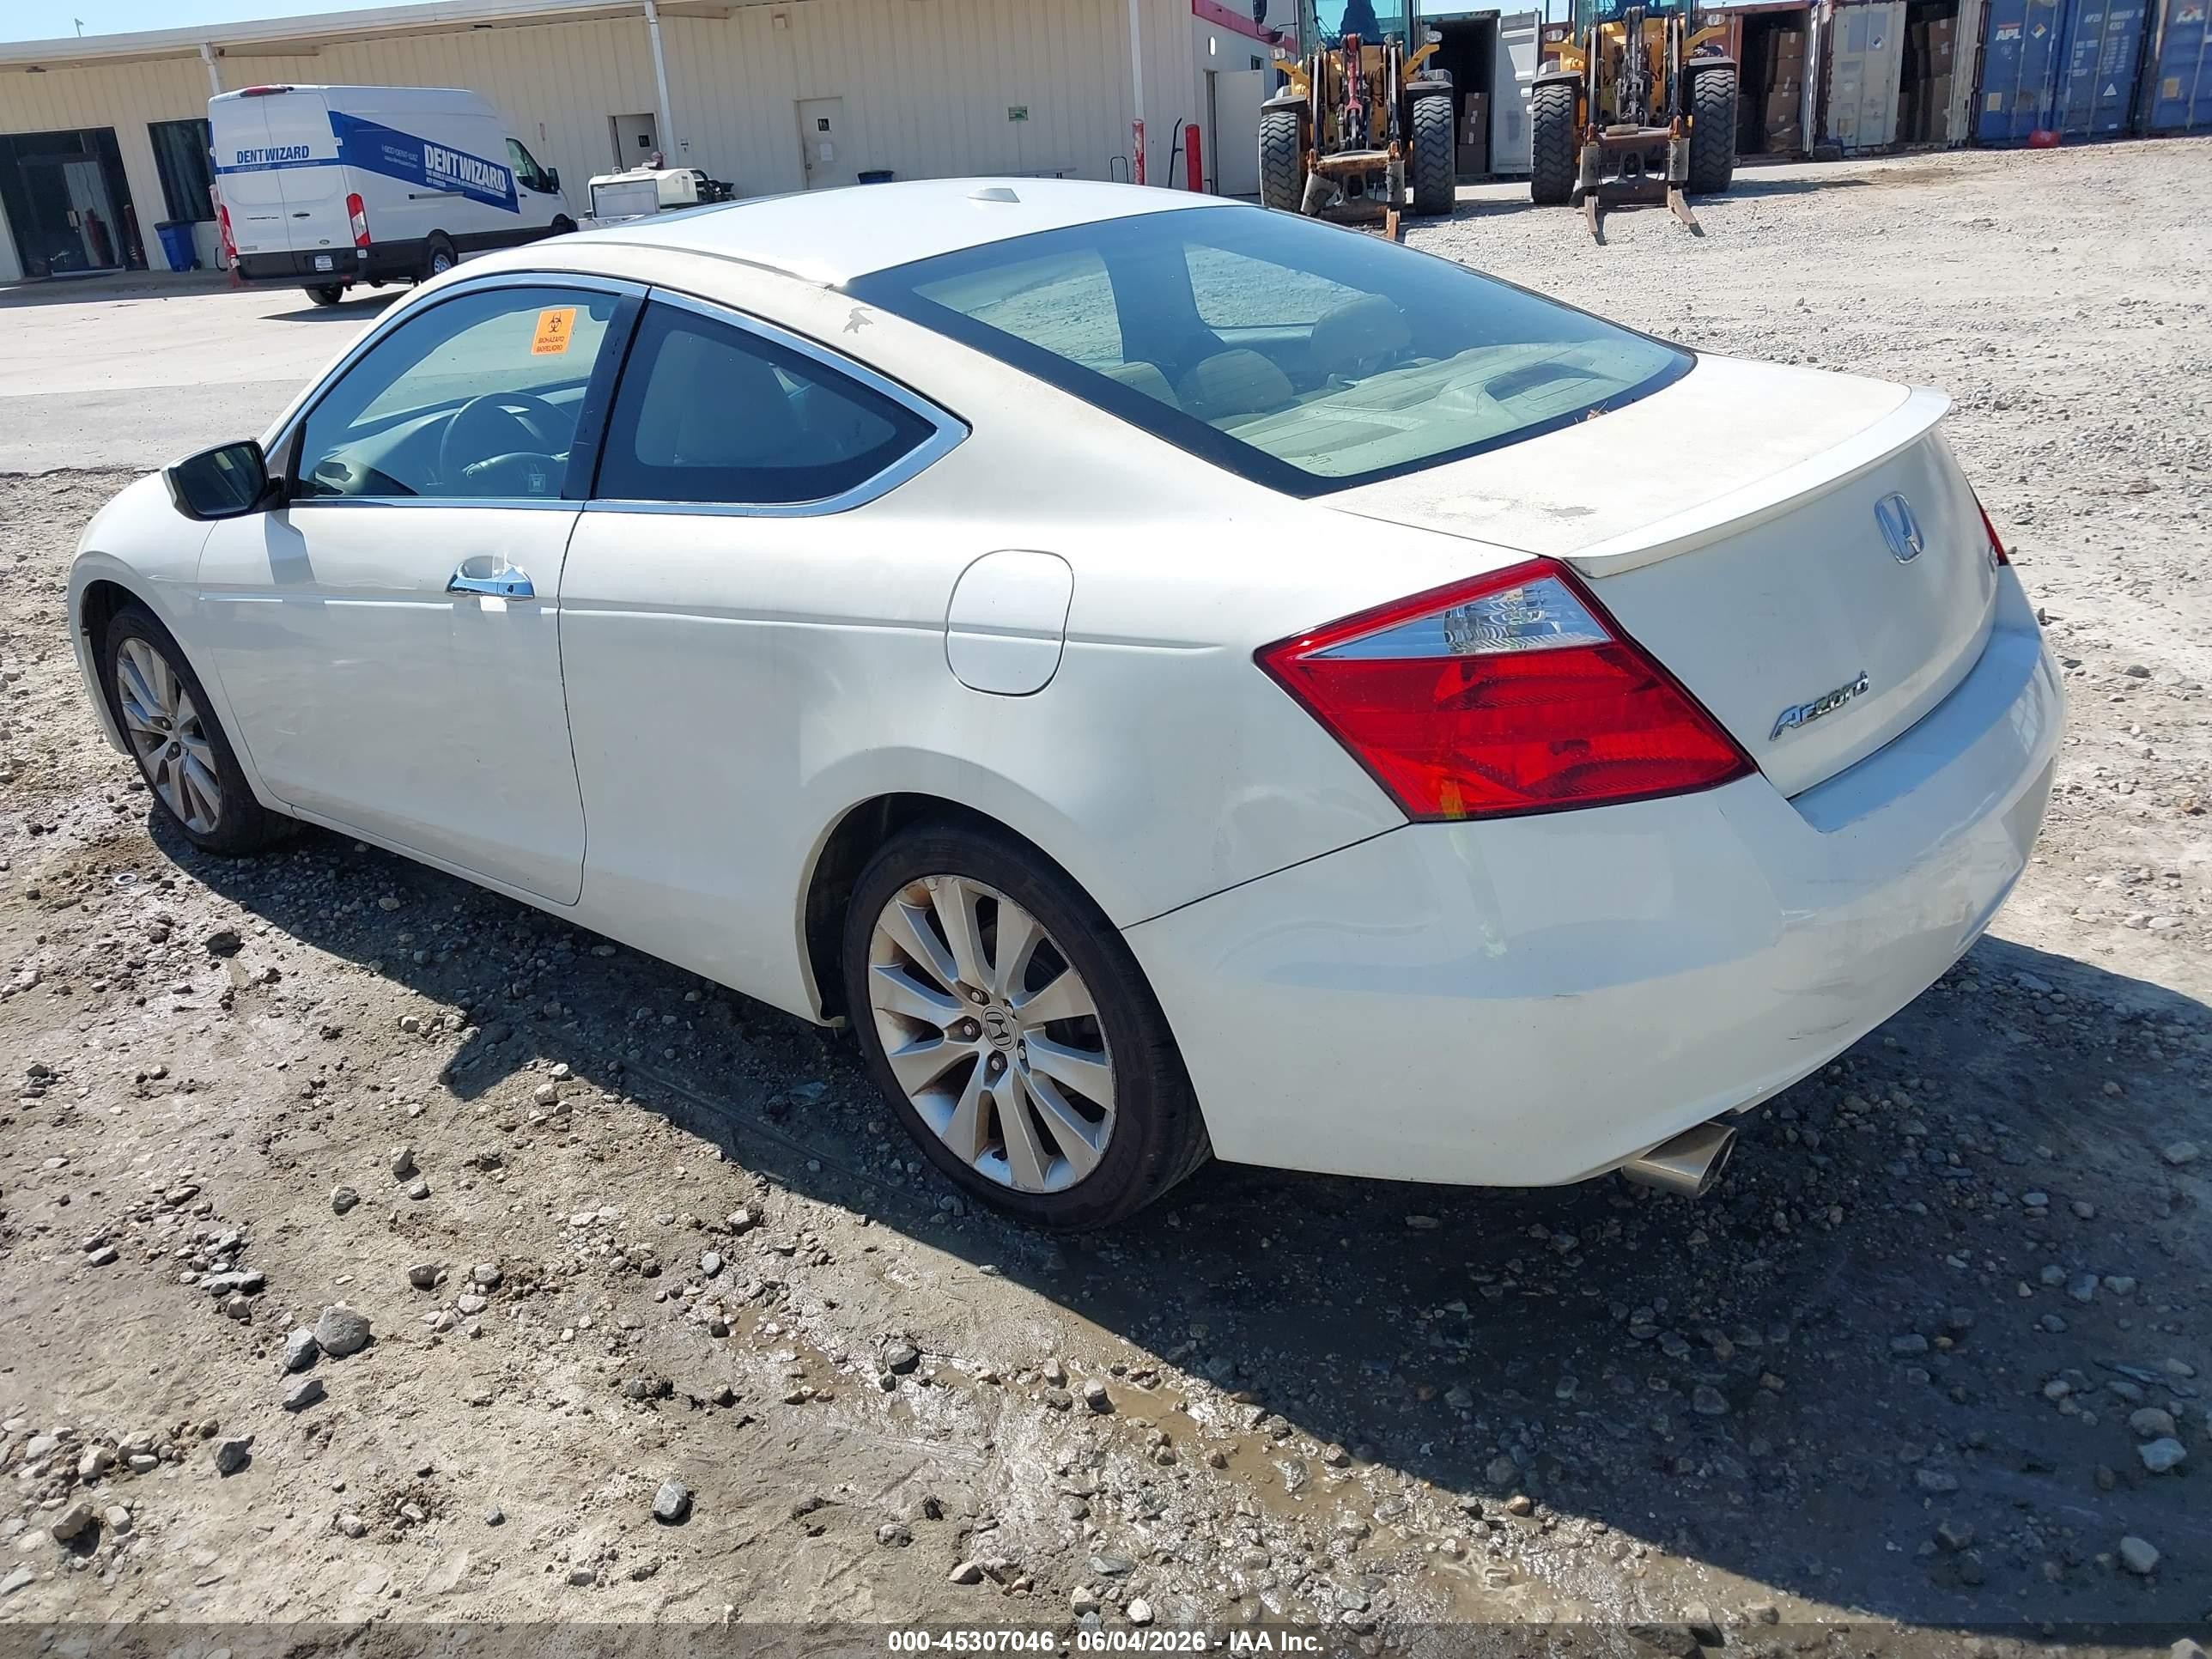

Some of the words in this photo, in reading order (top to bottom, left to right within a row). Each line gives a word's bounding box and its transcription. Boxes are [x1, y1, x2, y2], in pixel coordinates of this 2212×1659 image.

[1995, 28, 2021, 40] APL
[236, 149, 264, 164] DENT
[264, 145, 310, 161] WIZARD
[424, 143, 459, 177] DENT
[459, 155, 507, 192] WIZARD
[1768, 670, 1869, 741] Accord
